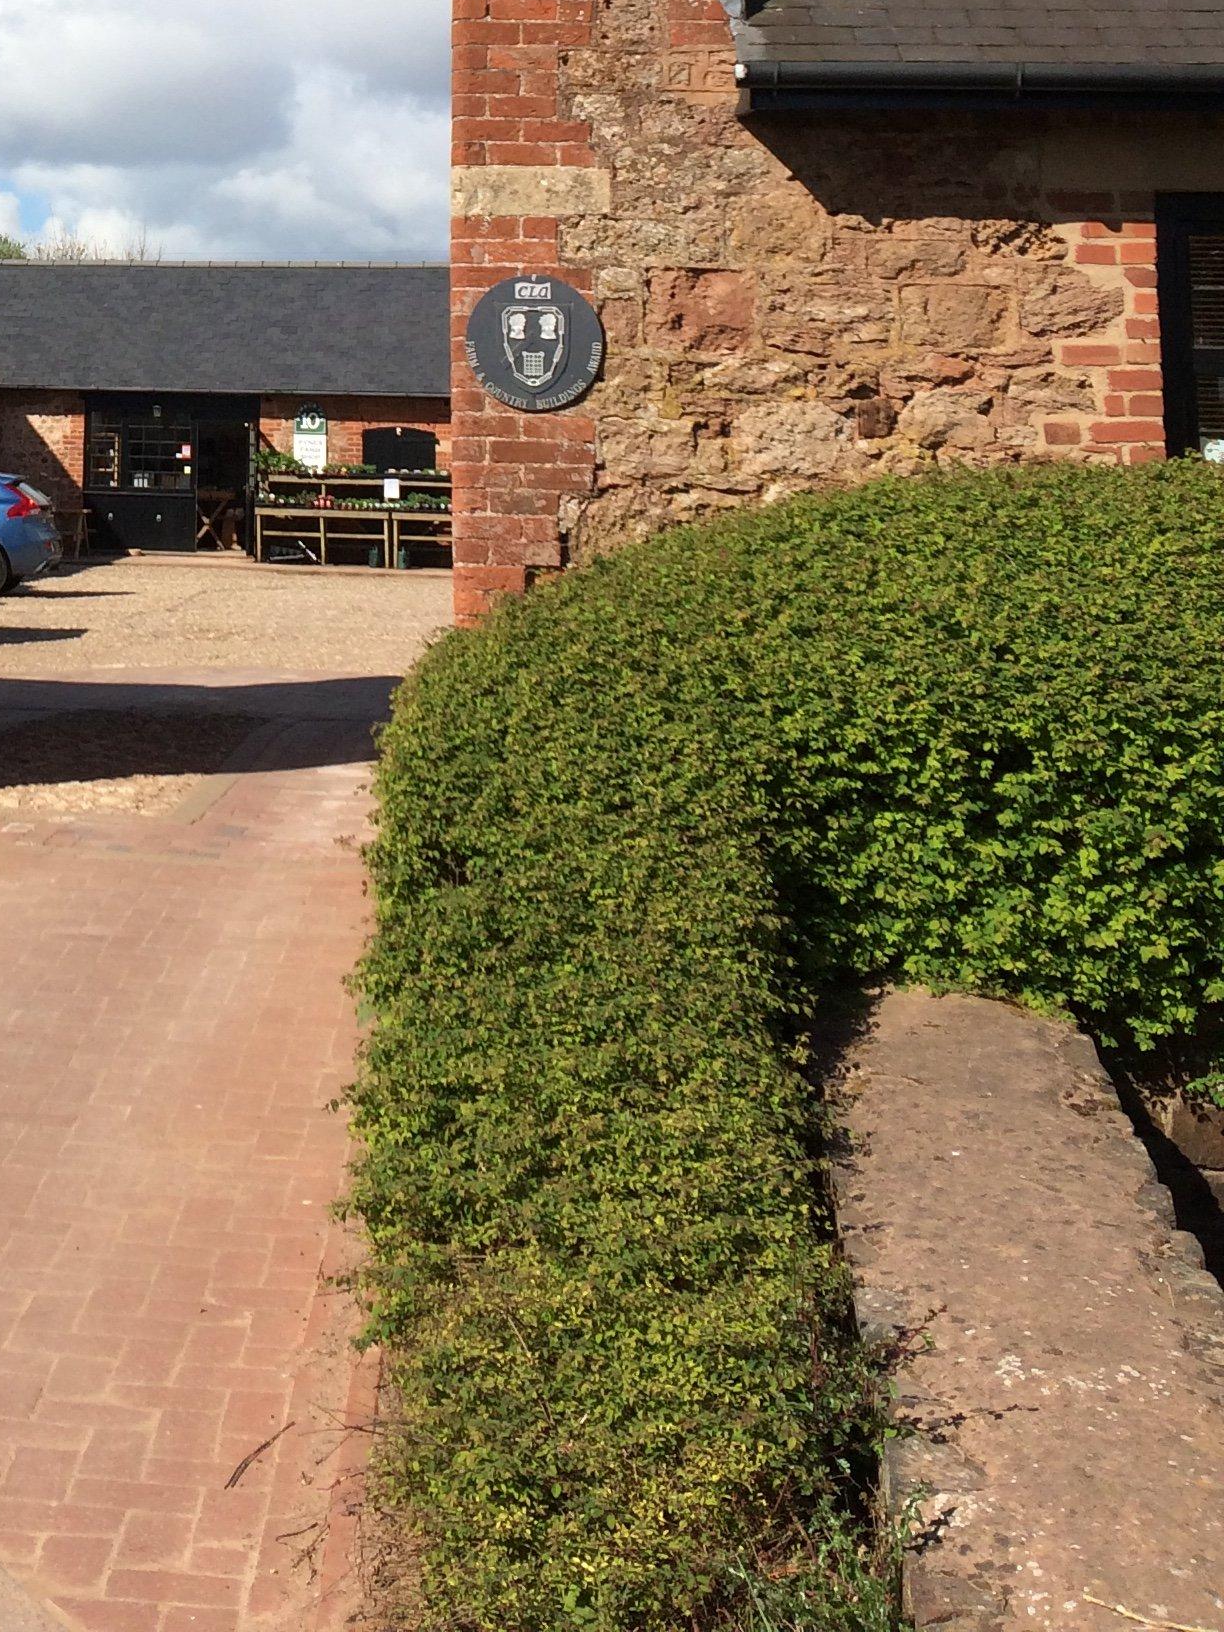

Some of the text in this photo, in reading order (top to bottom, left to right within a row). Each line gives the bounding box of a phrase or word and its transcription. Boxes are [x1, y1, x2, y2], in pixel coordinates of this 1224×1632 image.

[465, 340, 480, 368] FARM
[485, 381, 527, 409] COUNTRY
[536, 378, 587, 410] BUILDINGS
[586, 341, 602, 374] AWARD
[300, 412, 320, 429] 10
